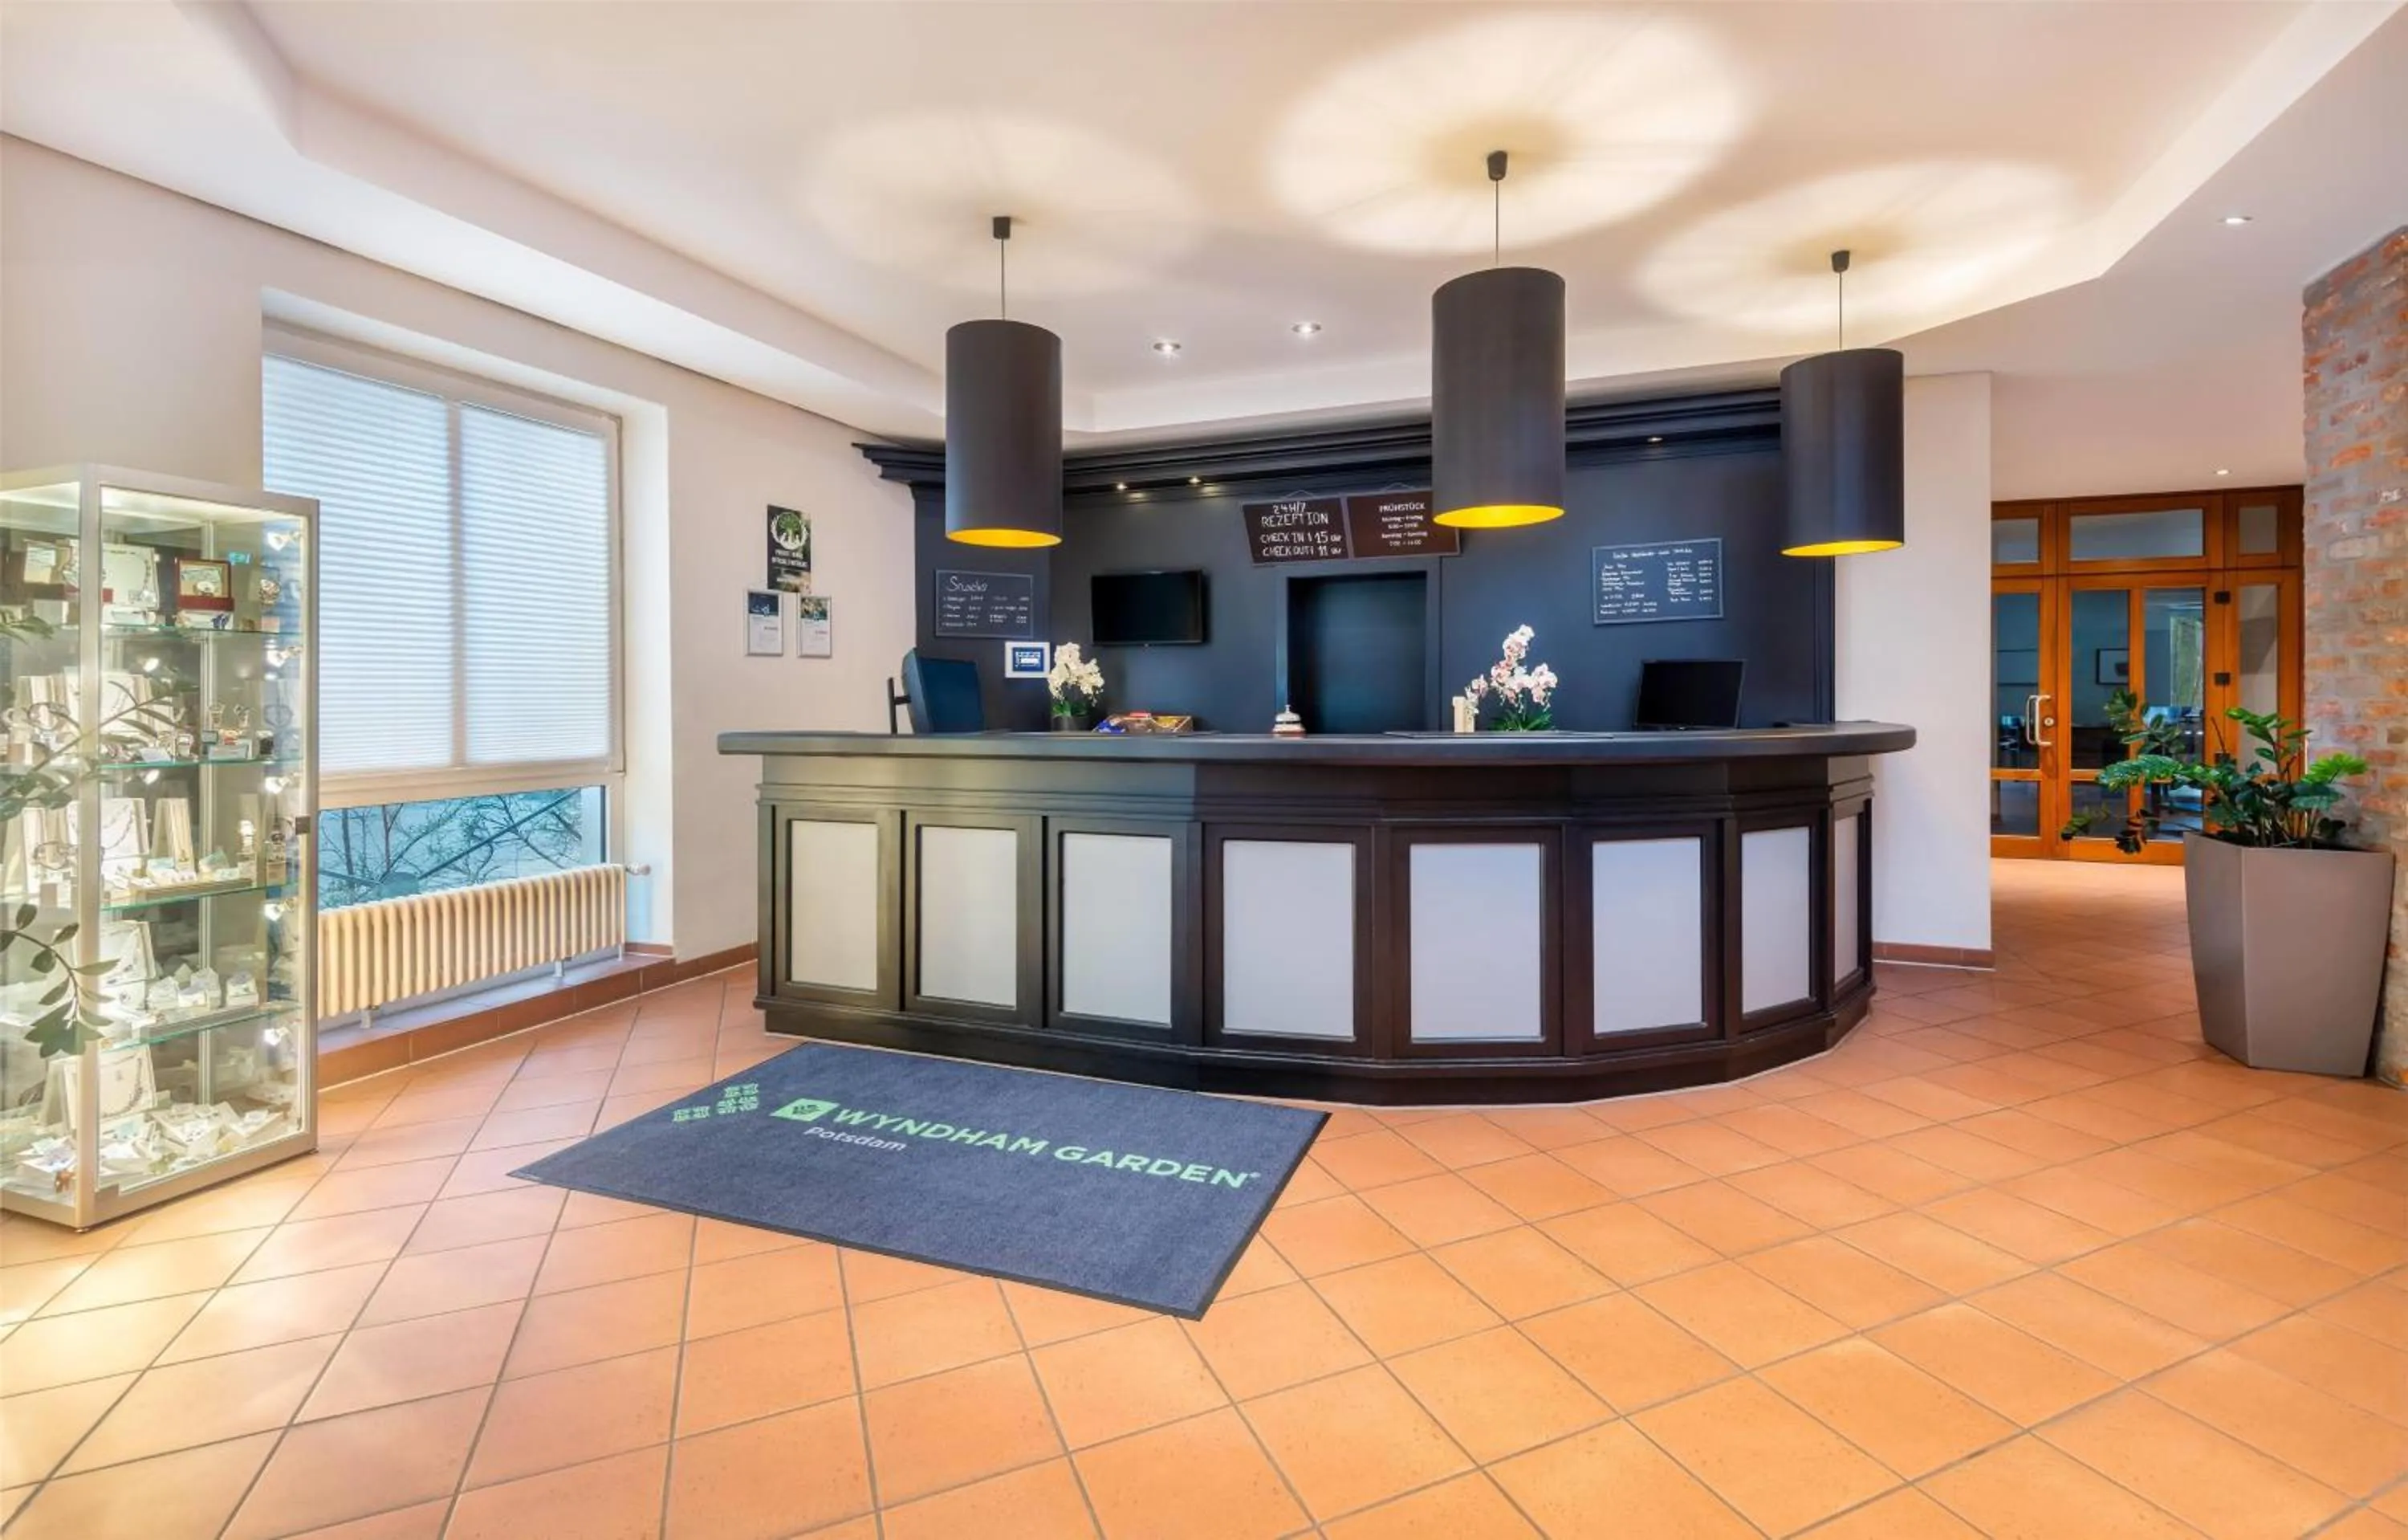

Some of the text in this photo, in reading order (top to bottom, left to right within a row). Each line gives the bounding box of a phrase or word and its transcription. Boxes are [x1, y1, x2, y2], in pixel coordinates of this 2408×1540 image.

[1260, 511, 1329, 528] REZEPTION
[1259, 532, 1290, 544] CHECK
[1315, 531, 1328, 543] 15
[1263, 545, 1291, 556] CHECK
[803, 1126, 907, 1151] Potsdam
[833, 1109, 1248, 1188] WYNDHAM GARDEN
